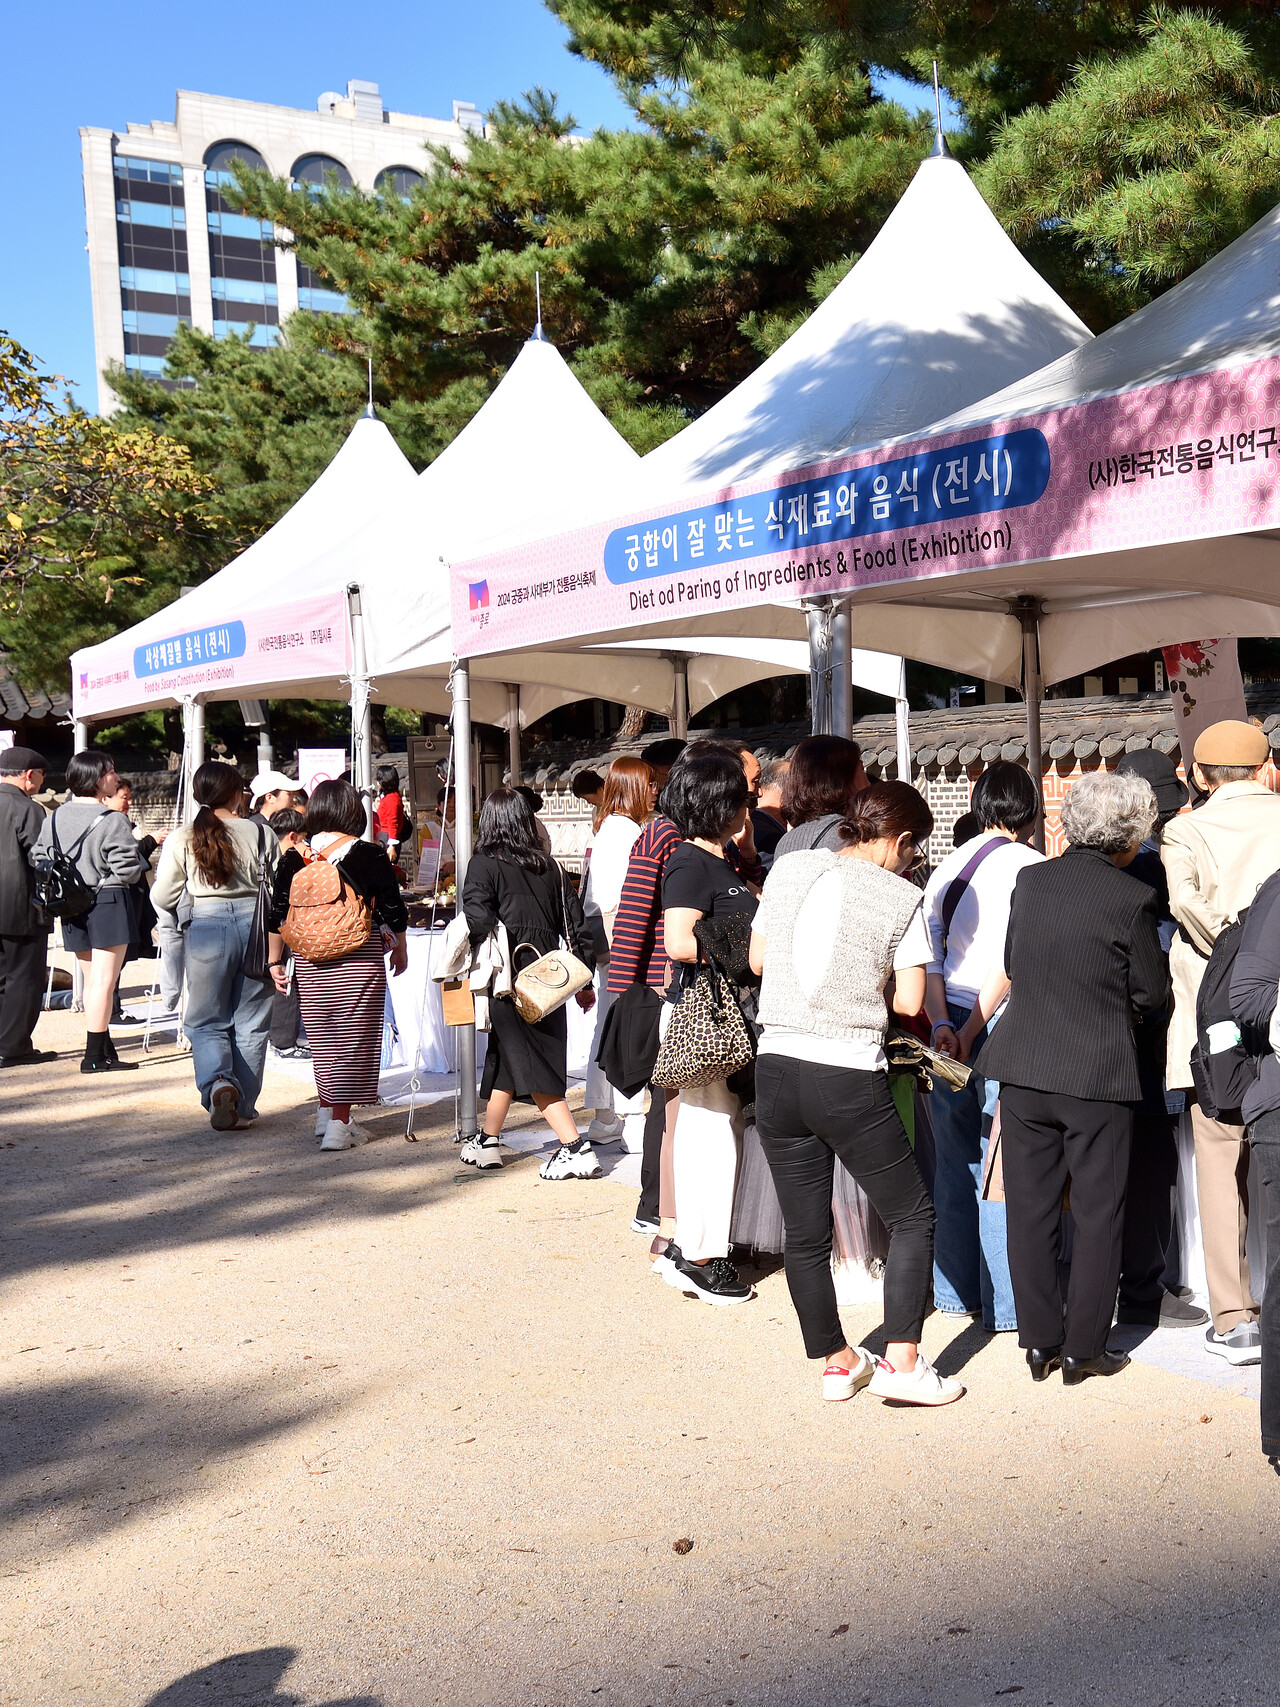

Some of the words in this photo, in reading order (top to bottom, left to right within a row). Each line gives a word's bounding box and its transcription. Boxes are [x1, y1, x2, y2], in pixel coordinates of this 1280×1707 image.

[624, 524, 678, 572] 궁합이
[687, 518, 706, 558] 잘
[714, 508, 755, 553] 맞는
[764, 482, 858, 540] 식재료와
[869, 467, 919, 520] 음식
[932, 448, 1013, 509] (전시)
[629, 589, 655, 611] Diet
[659, 584, 674, 606] od
[678, 578, 721, 601] Paring
[725, 571, 740, 594] of
[744, 556, 831, 591] Ingredients
[837, 551, 848, 574] &
[853, 542, 896, 571] Food
[902, 521, 1011, 566] (Exhibition)
[497, 593, 511, 607] 2024
[511, 584, 529, 604] 궁중과
[530, 579, 556, 600] 사대부가
[185, 635, 201, 661] 음식
[205, 628, 230, 657] (전시)
[144, 681, 155, 694] Food
